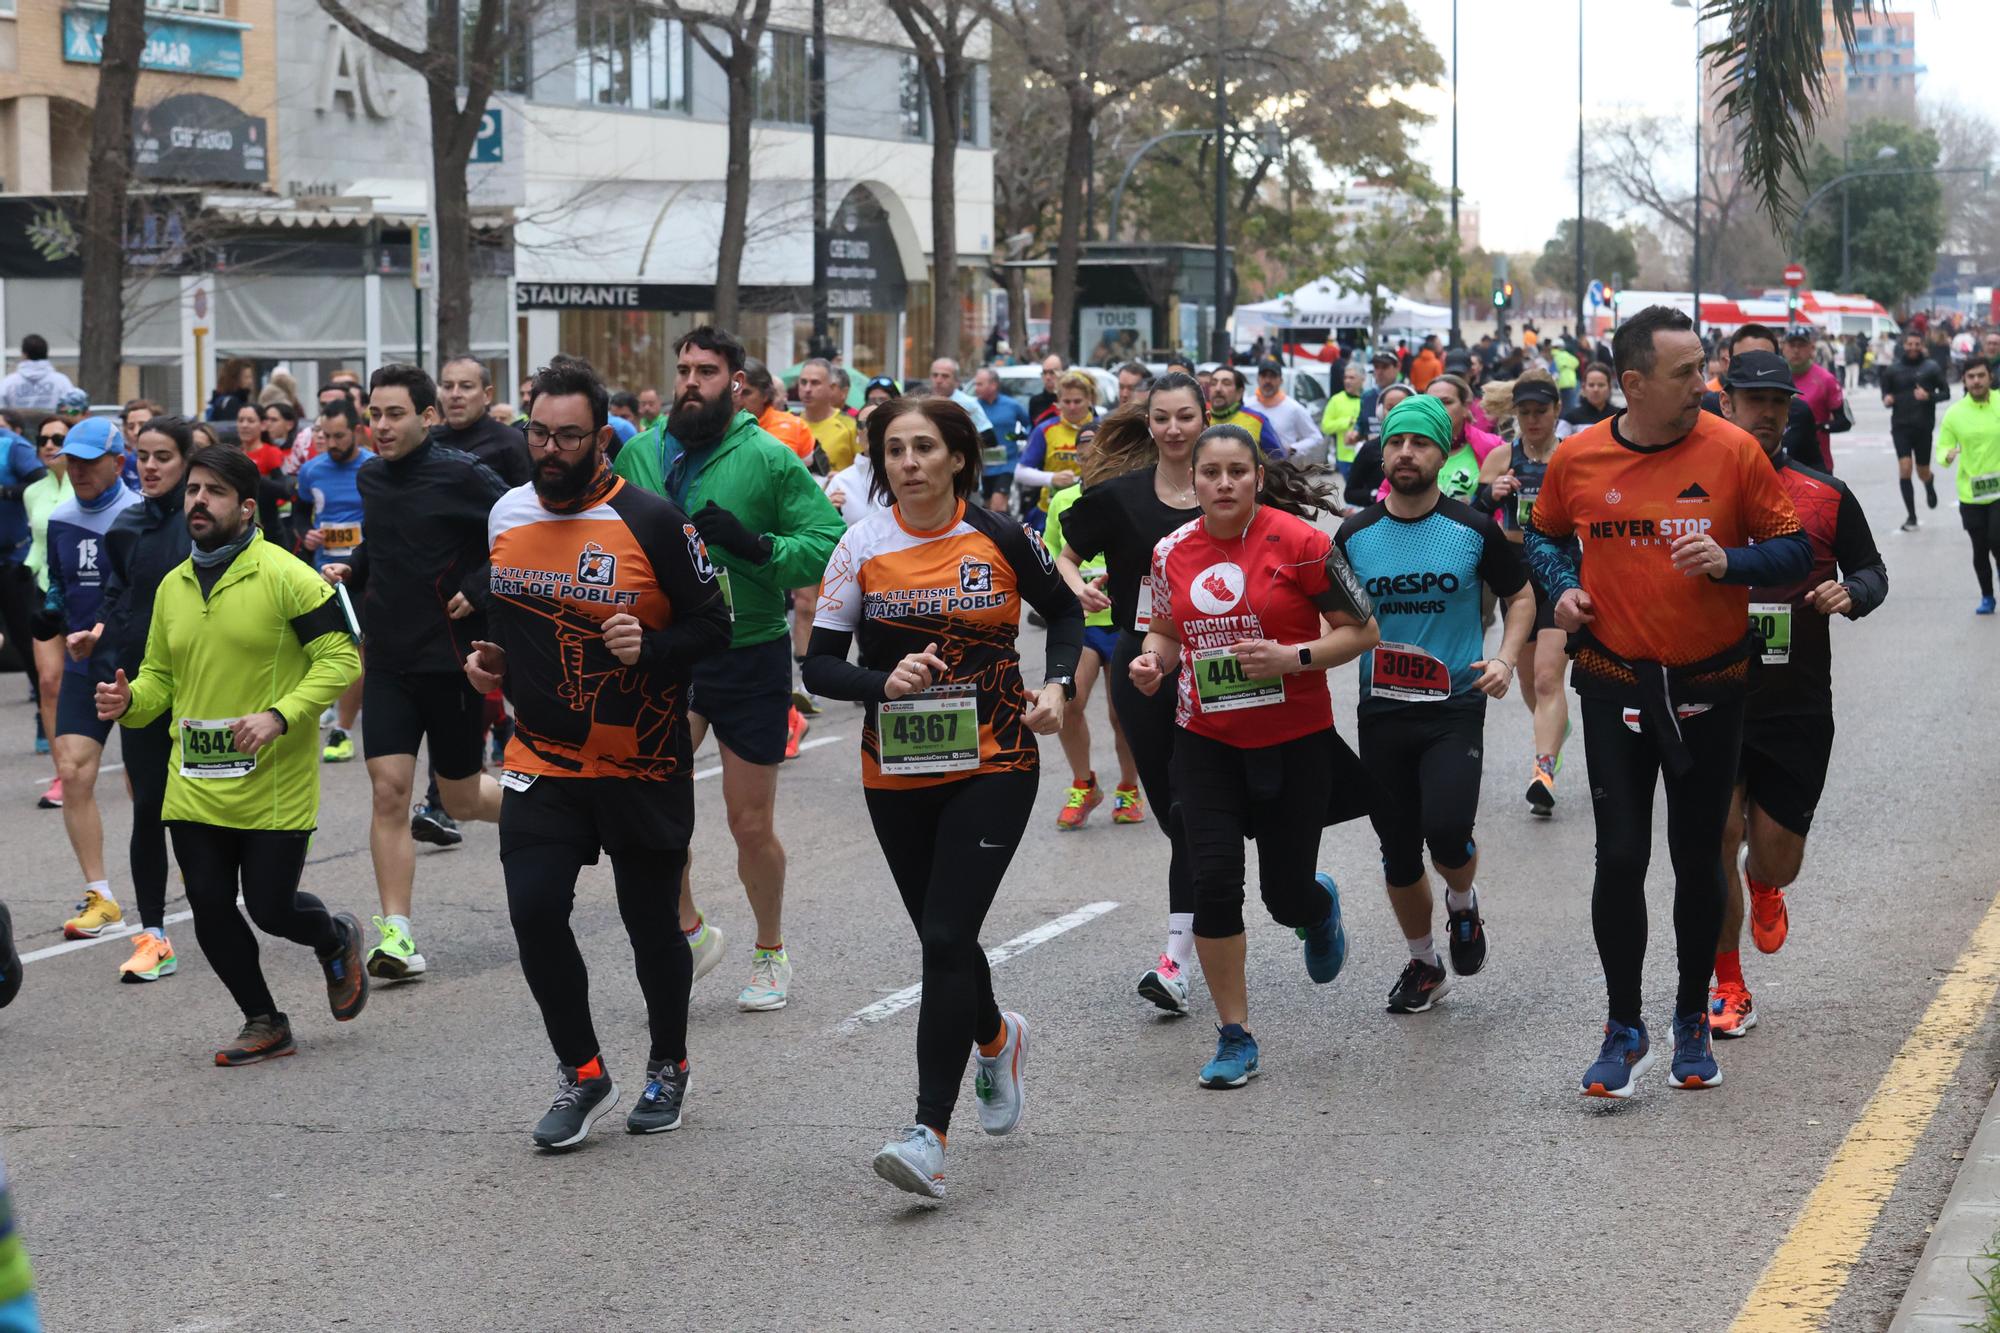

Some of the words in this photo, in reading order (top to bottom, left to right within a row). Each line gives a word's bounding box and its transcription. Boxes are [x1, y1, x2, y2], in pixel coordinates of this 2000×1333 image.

[517, 285, 639, 305] STAURANTE
[1096, 312, 1136, 326] TOUS
[1590, 520, 1656, 538] NEVER
[1660, 518, 1711, 536] STOP
[501, 567, 572, 583] ATLETISME
[1366, 572, 1459, 597] CRESPO
[528, 582, 555, 598] DE
[559, 586, 641, 606] POBLET
[885, 587, 956, 600] ATLETISME
[865, 601, 912, 621] QUART
[916, 599, 944, 614] DE
[947, 593, 1007, 613] POBLET
[1379, 600, 1445, 614] RUNNERS
[1183, 616, 1239, 635] CIRCUIT
[1241, 614, 1260, 629] DE
[1382, 652, 1438, 680] 3052
[893, 713, 958, 744] 4367
